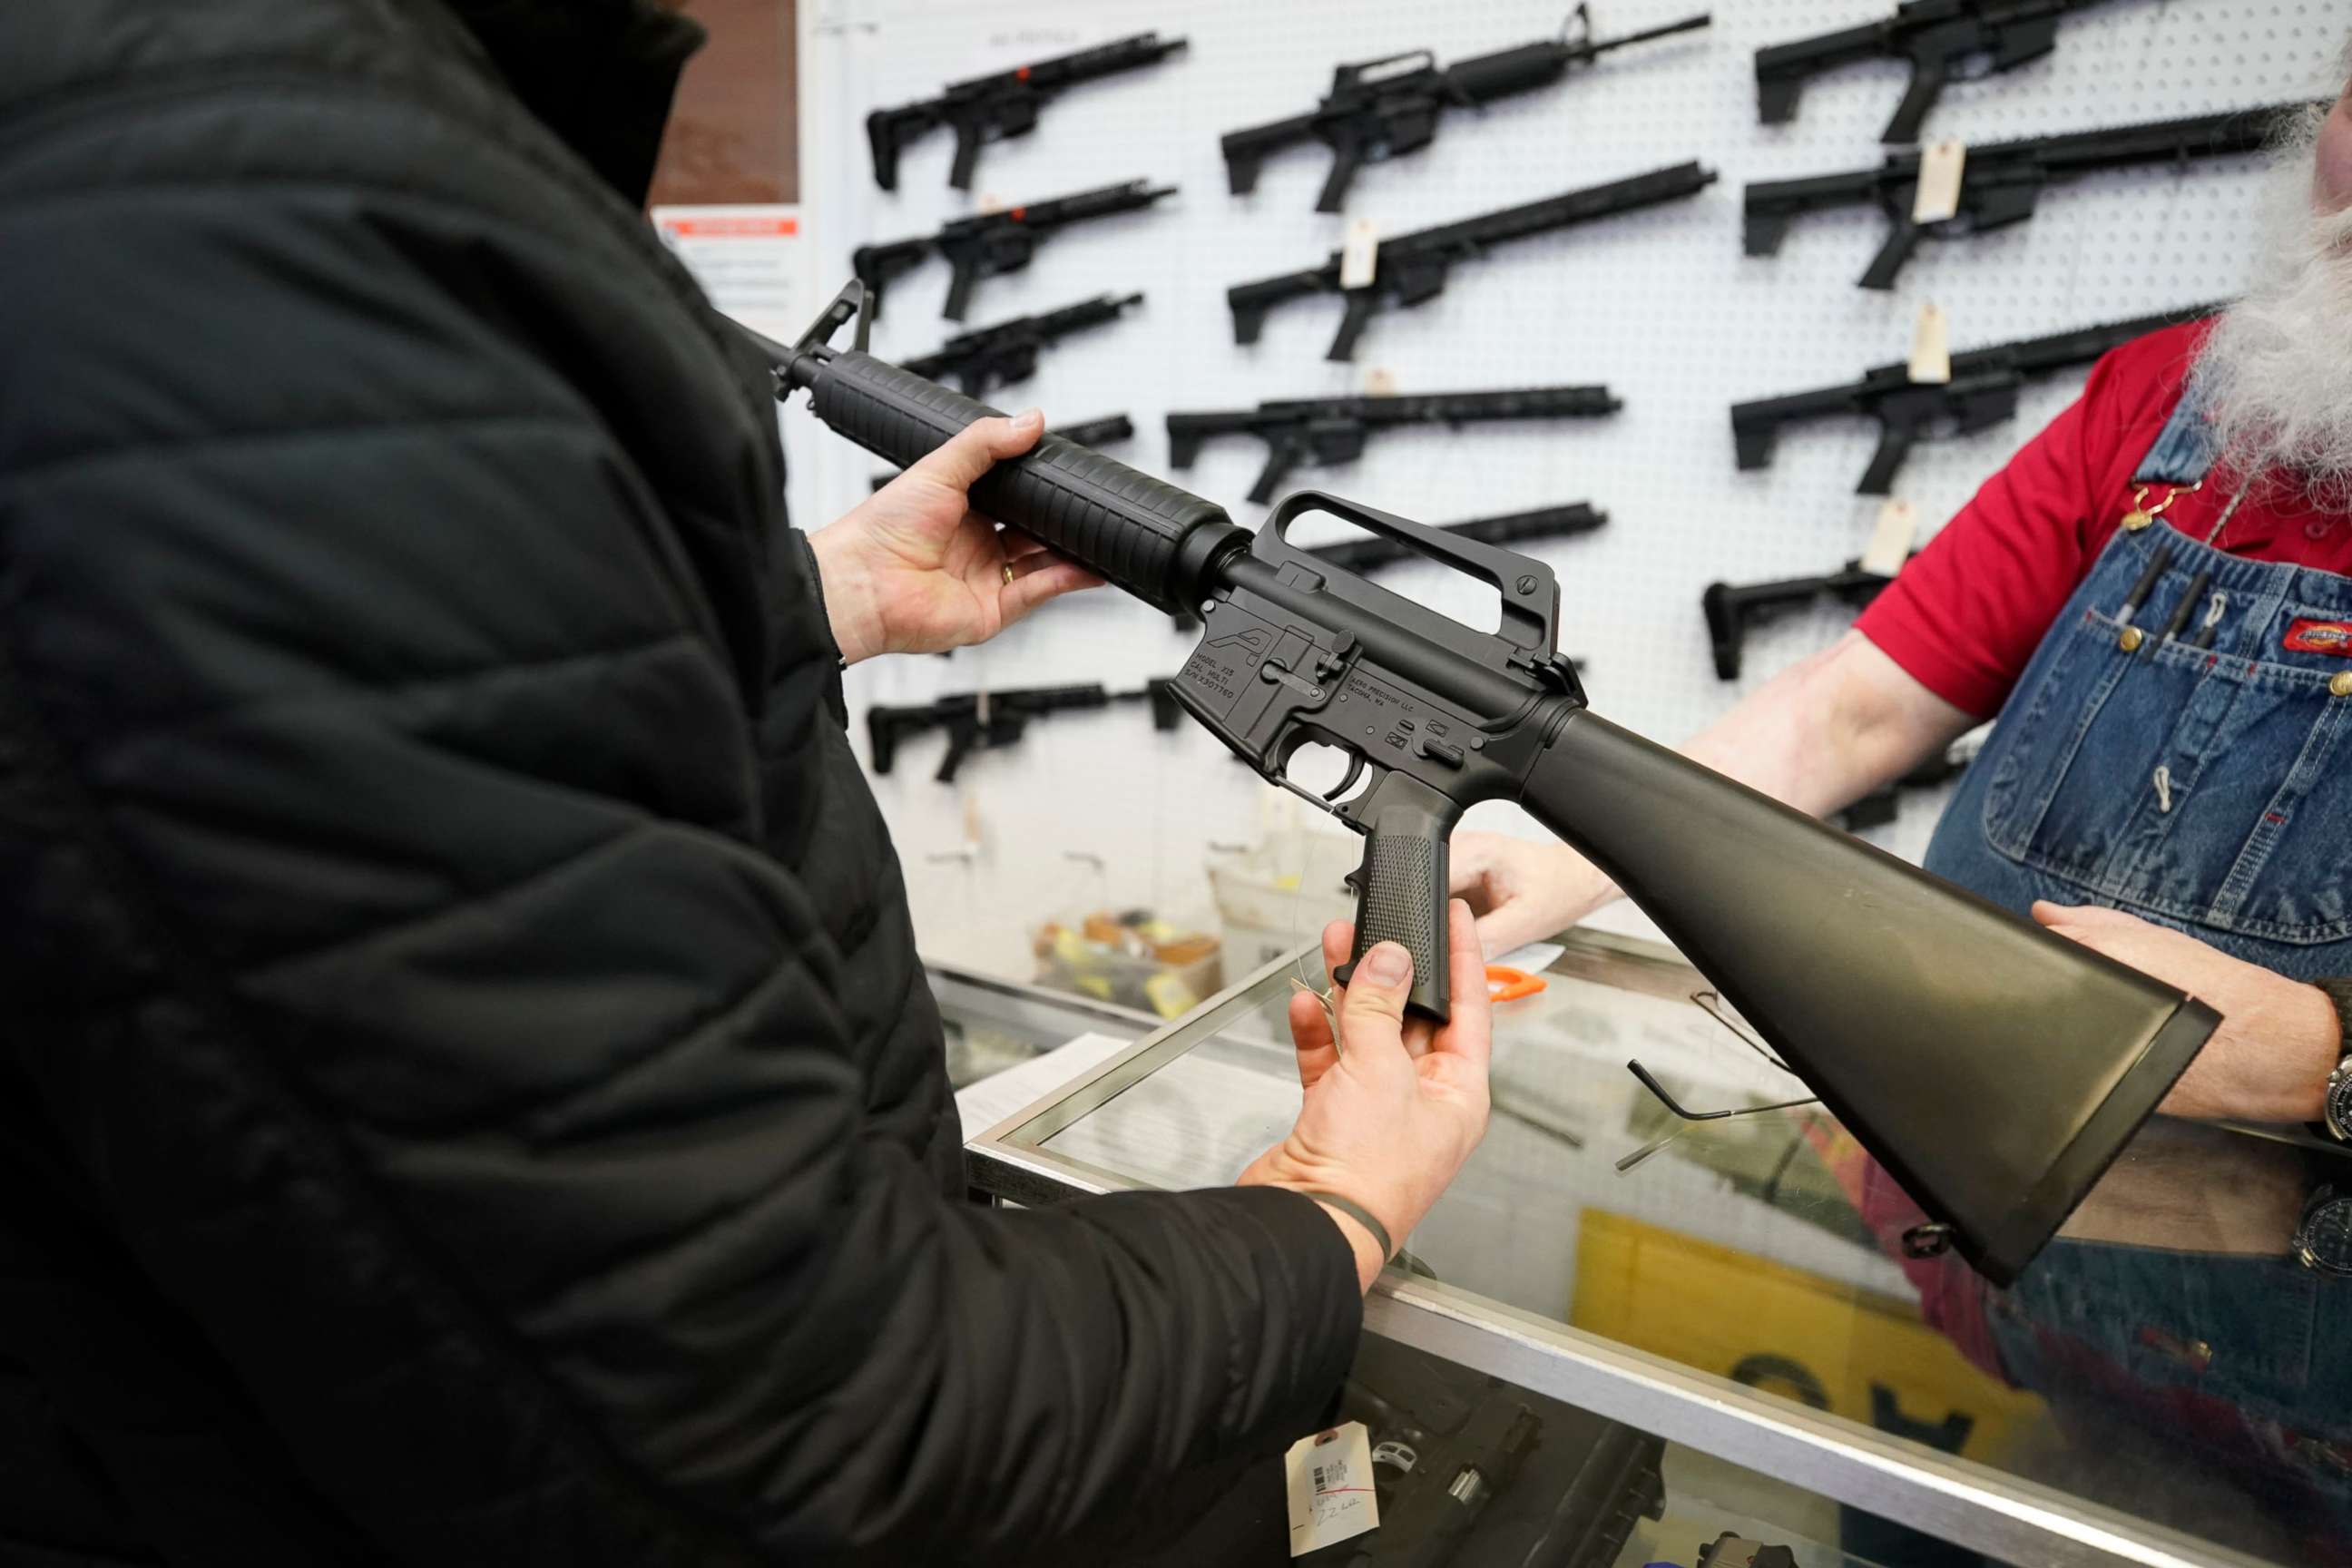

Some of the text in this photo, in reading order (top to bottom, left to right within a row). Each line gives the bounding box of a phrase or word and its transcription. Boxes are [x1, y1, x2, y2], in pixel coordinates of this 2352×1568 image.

[1195, 652, 1217, 669] MODEL
[1190, 661, 1229, 685] CAL MULTI
